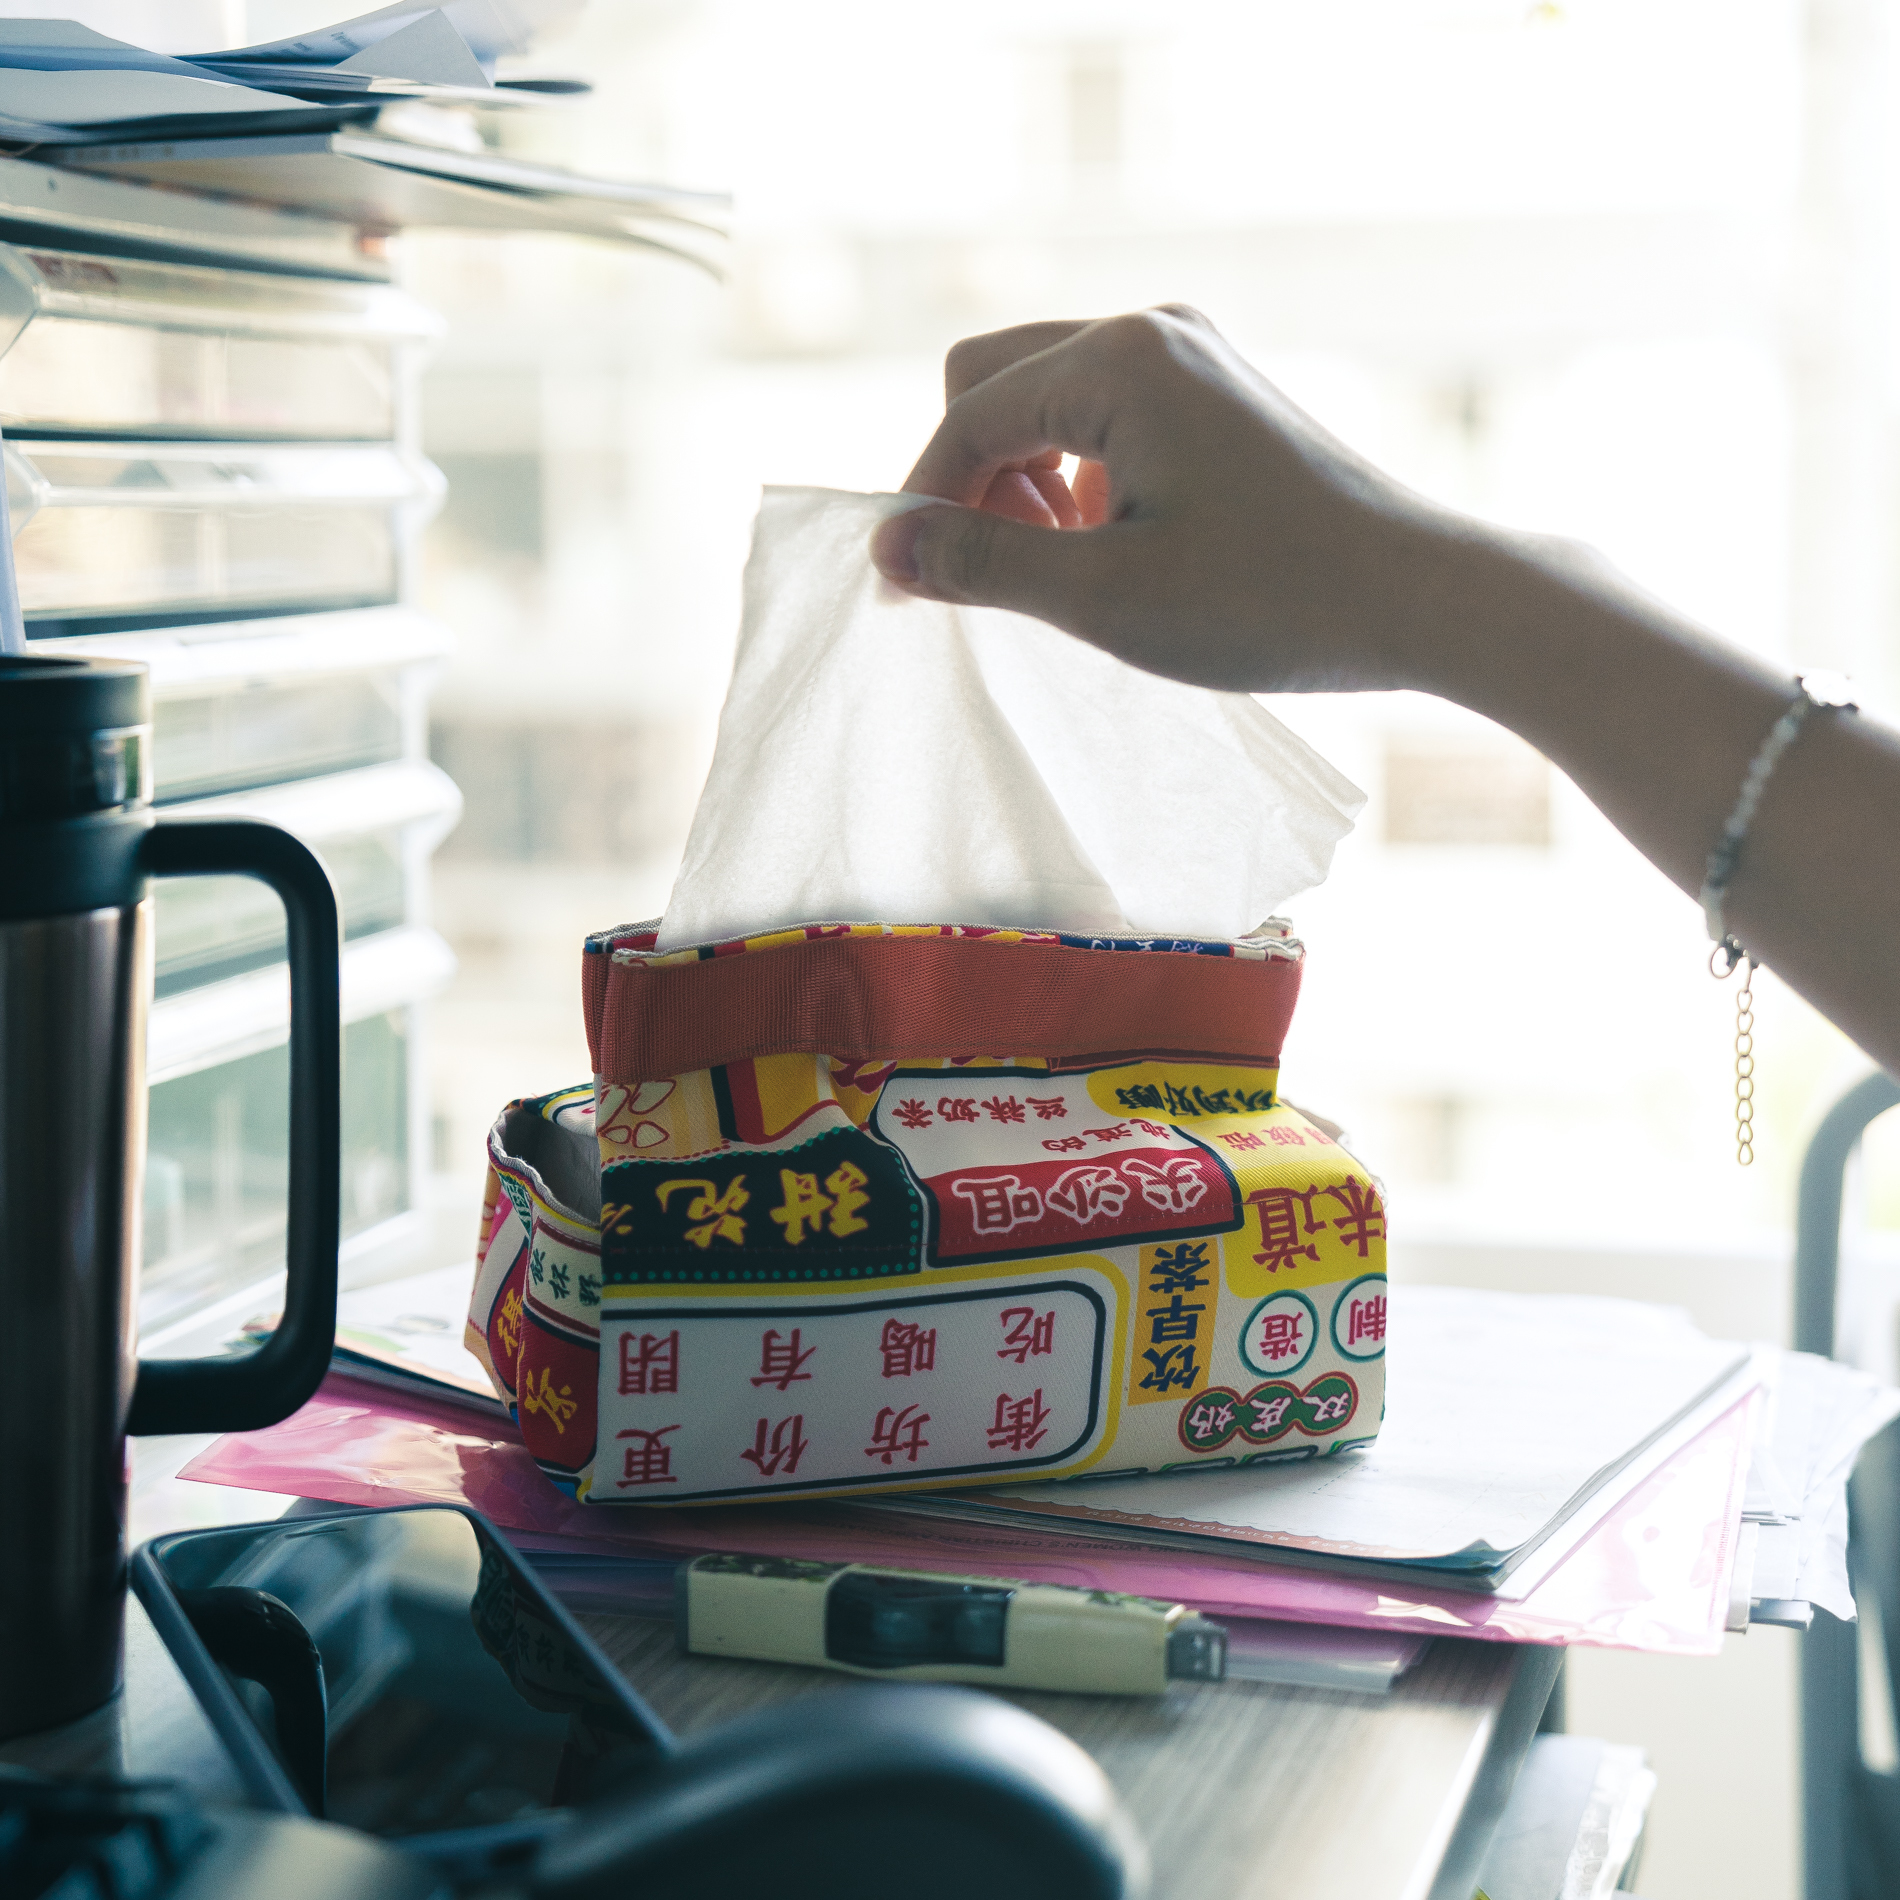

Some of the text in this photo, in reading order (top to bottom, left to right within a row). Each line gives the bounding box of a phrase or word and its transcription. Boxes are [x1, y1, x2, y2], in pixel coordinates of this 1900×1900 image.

[892, 1095, 1069, 1129] 丝袜奶茶
[1042, 1117, 1172, 1151] 地道的
[951, 1155, 1210, 1236] 尖沙咀
[1250, 1172, 1387, 1274] 味道
[1139, 1241, 1209, 1394] 饮早茶
[615, 1387, 1054, 1489] 街坊价更
[1186, 1388, 1354, 1444] 双皮奶
